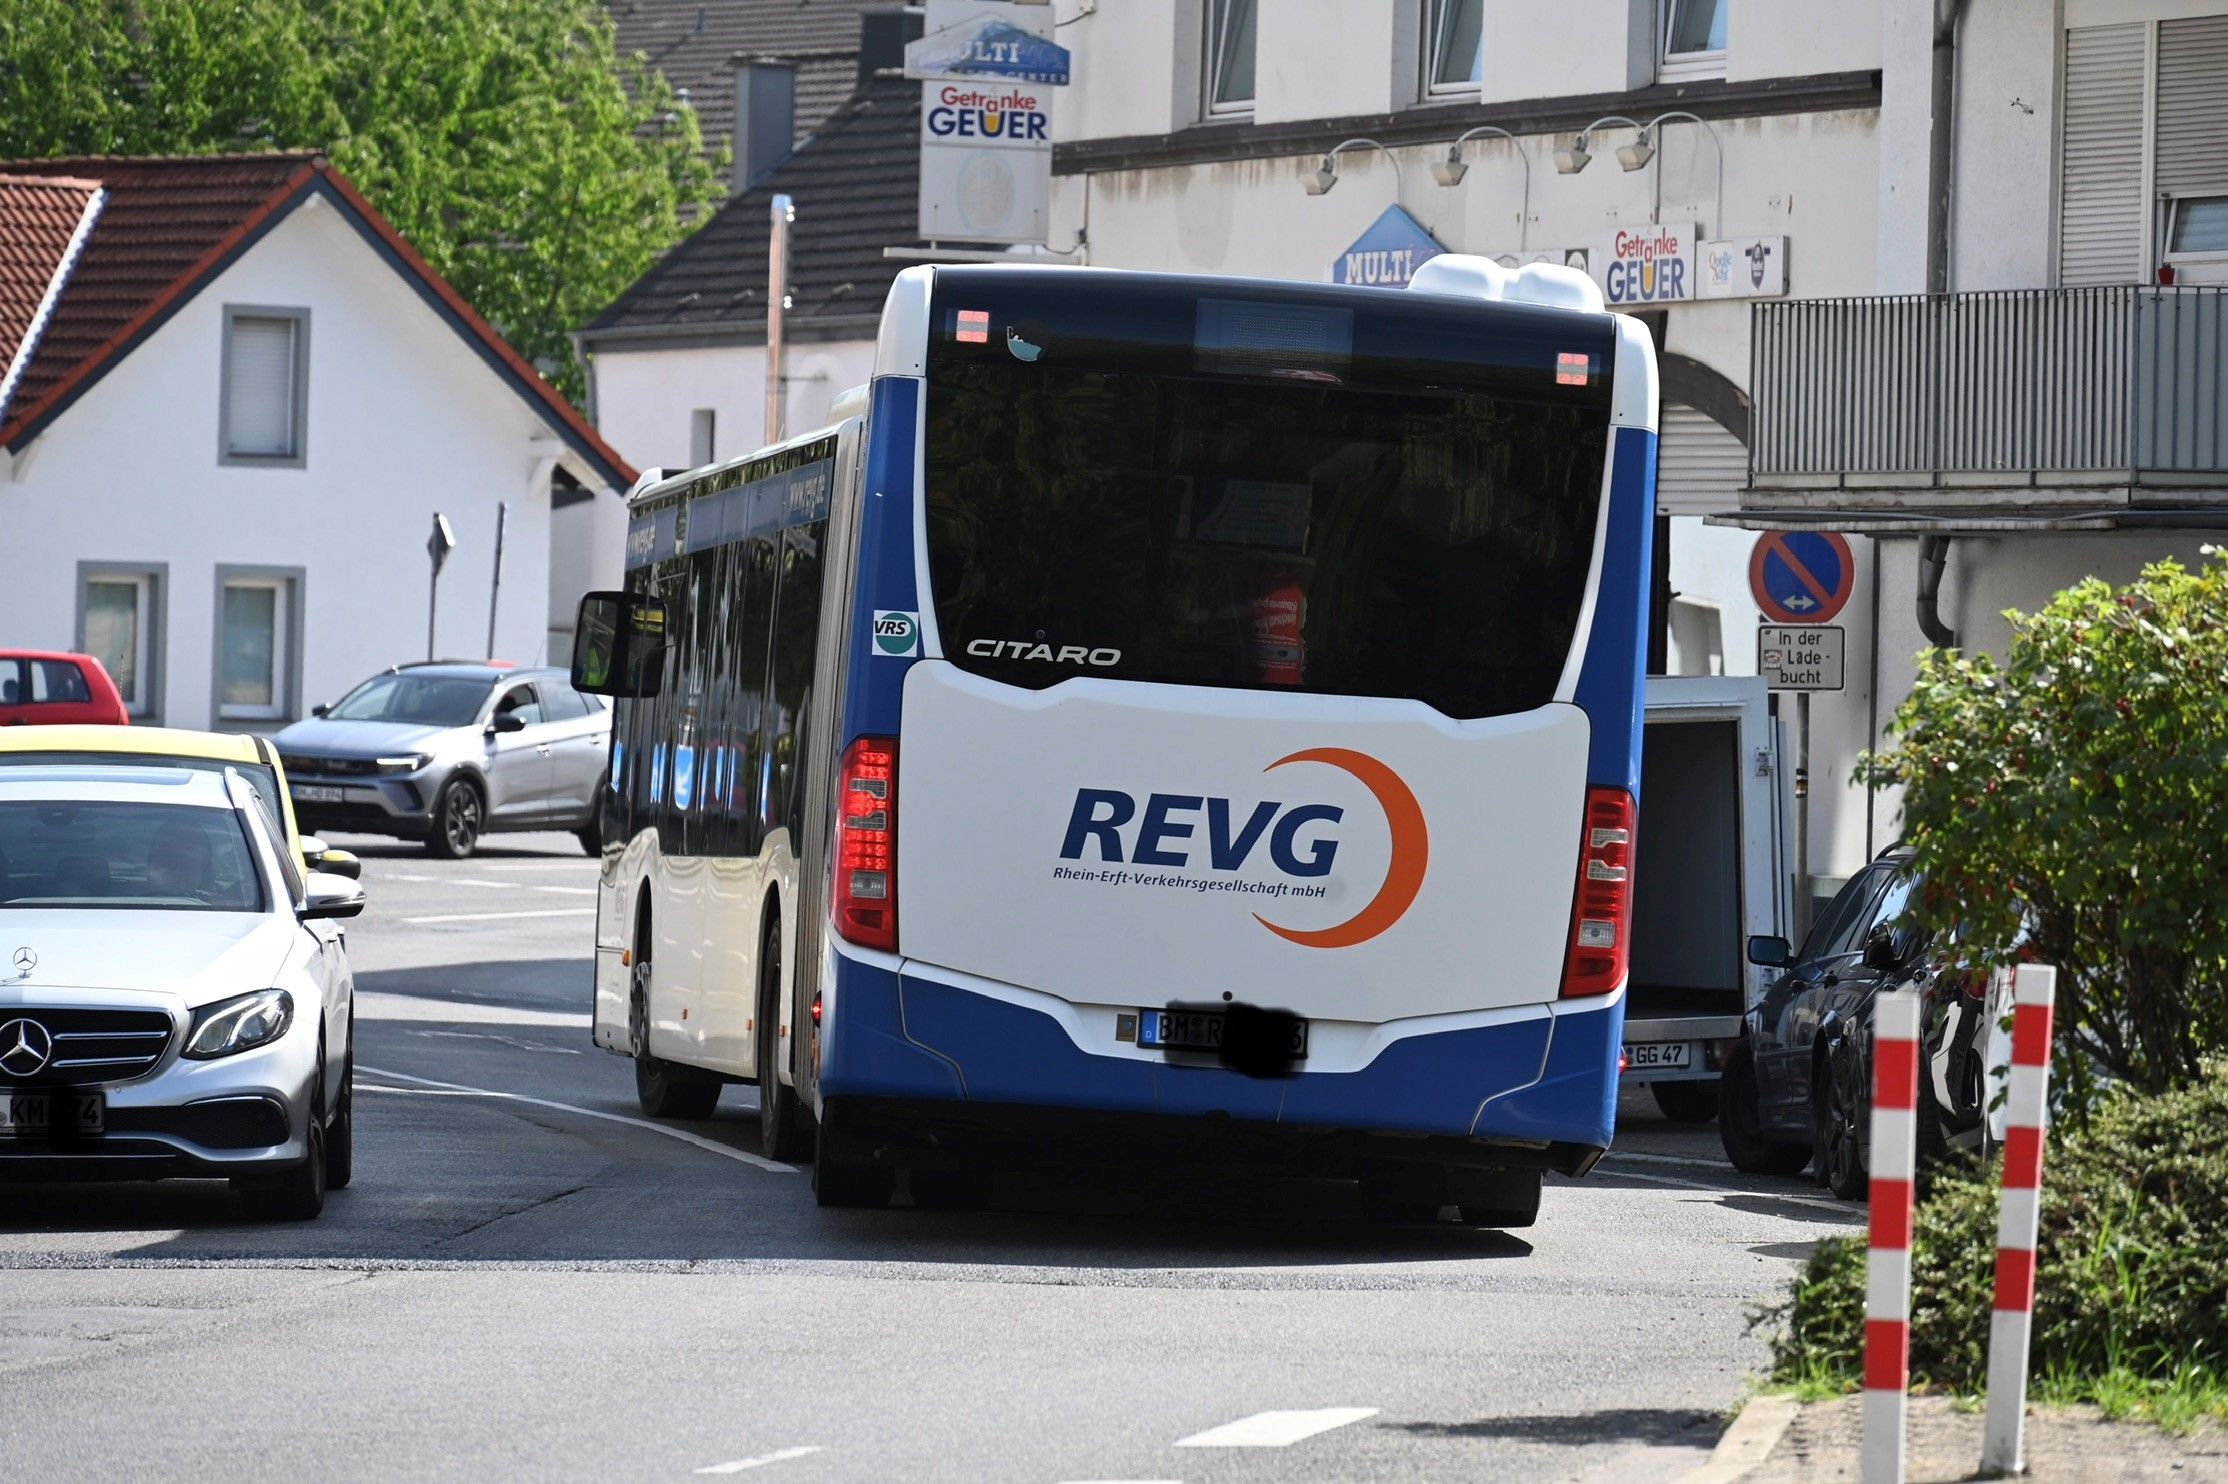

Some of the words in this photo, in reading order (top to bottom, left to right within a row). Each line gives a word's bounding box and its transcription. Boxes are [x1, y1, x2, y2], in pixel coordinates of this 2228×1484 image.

[957, 40, 1020, 63] ULTI
[928, 107, 1047, 139] GEUER
[1345, 249, 1413, 284] MULTI
[1607, 257, 1685, 302] GEUER
[873, 620, 907, 635] VRS
[1779, 630, 1792, 645] In
[1798, 630, 1822, 645] der
[966, 638, 1122, 666] CITARO
[1780, 669, 1821, 684] bucht
[1059, 788, 1344, 877] REVG
[1053, 867, 1289, 897] Rhein-Erft-Verkehrsgesellschaft
[1291, 885, 1326, 898] mbH
[1636, 1046, 1658, 1064] GG
[1662, 1044, 1682, 1064] 47
